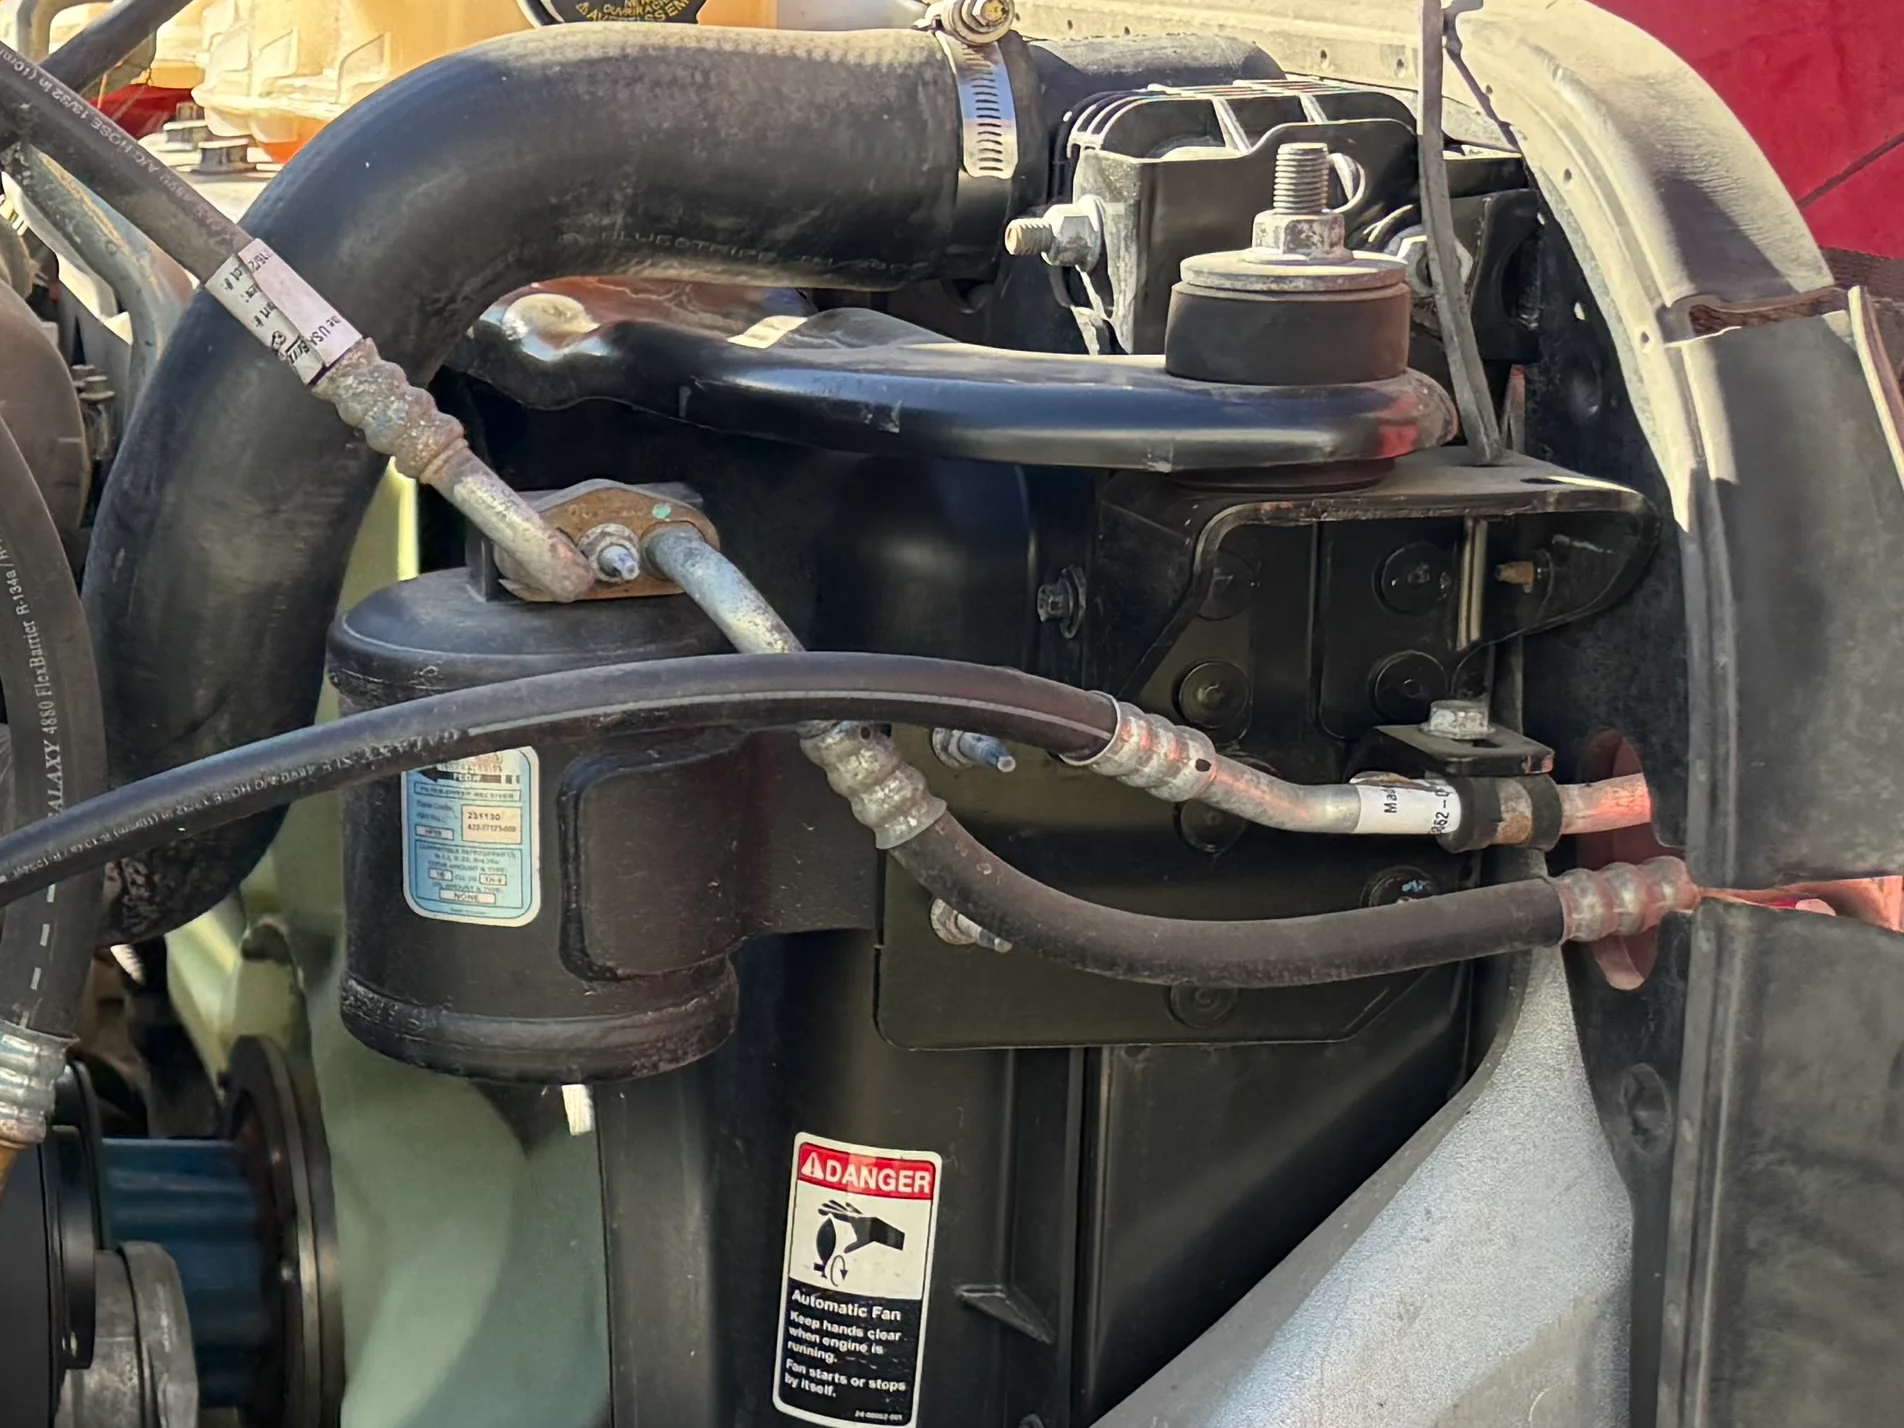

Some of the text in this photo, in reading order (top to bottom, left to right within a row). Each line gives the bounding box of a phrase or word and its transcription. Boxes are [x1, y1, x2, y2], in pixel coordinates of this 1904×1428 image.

[89, 117, 134, 154] HOSE
[6, 571, 30, 615] R-134a
[23, 620, 52, 697] FlexBarrier
[38, 699, 58, 735] 4880
[45, 739, 65, 818] ALAXY
[825, 1161, 931, 1194] DANGER
[792, 1289, 901, 1321] Automatic Fan
[788, 1326, 884, 1355] when engine is
[790, 1310, 902, 1341] Keep hands clear
[787, 1340, 838, 1364] running.
[784, 1372, 837, 1398] by itself.
[785, 1358, 907, 1392] Fan starts or stops
